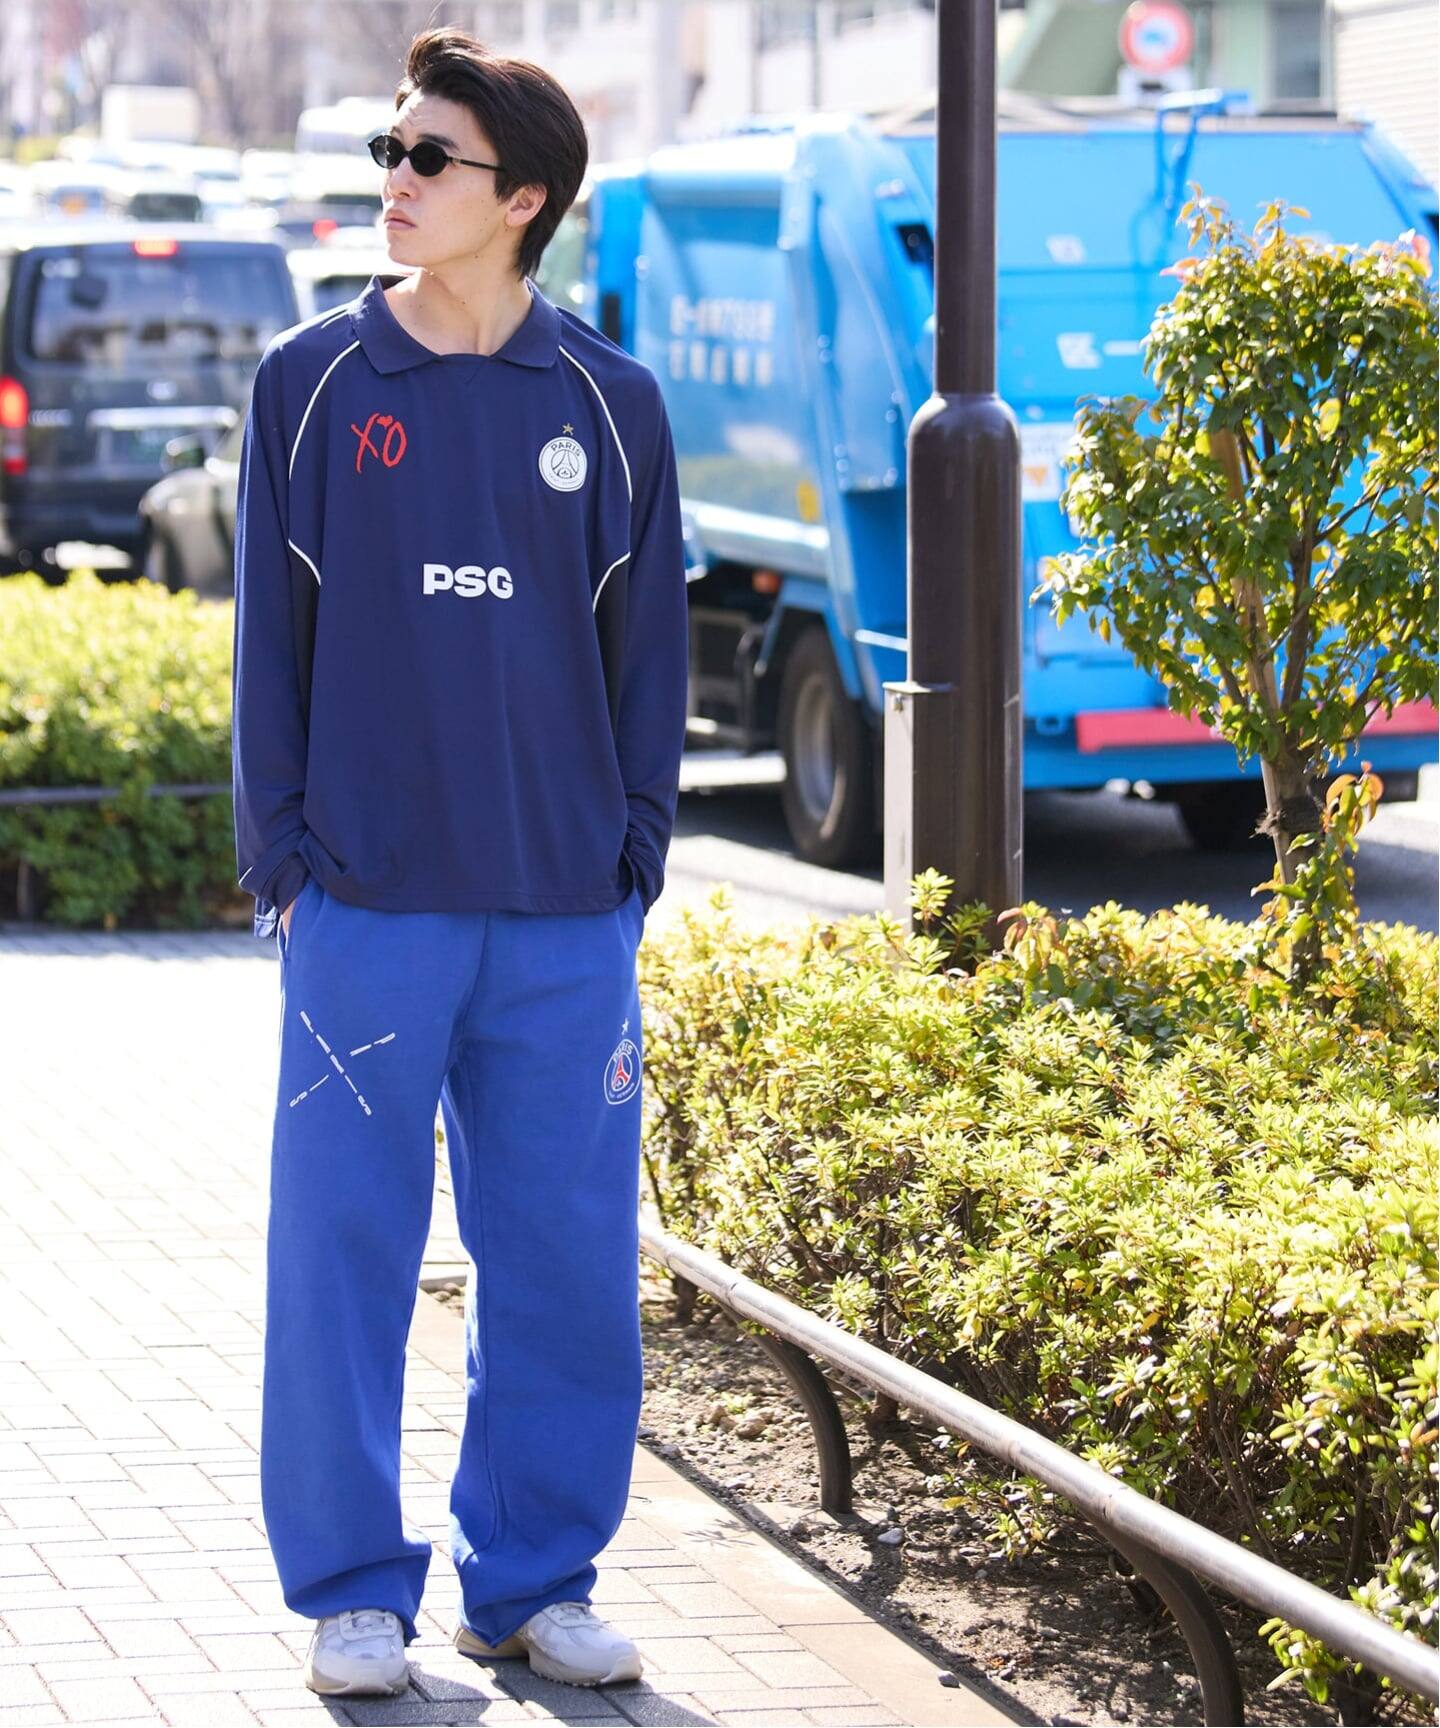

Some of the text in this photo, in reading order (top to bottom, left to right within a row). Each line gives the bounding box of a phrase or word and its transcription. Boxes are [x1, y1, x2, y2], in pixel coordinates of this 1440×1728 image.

[351, 413, 407, 474] XO
[551, 442, 581, 456] PARIS
[423, 564, 513, 599] PSG
